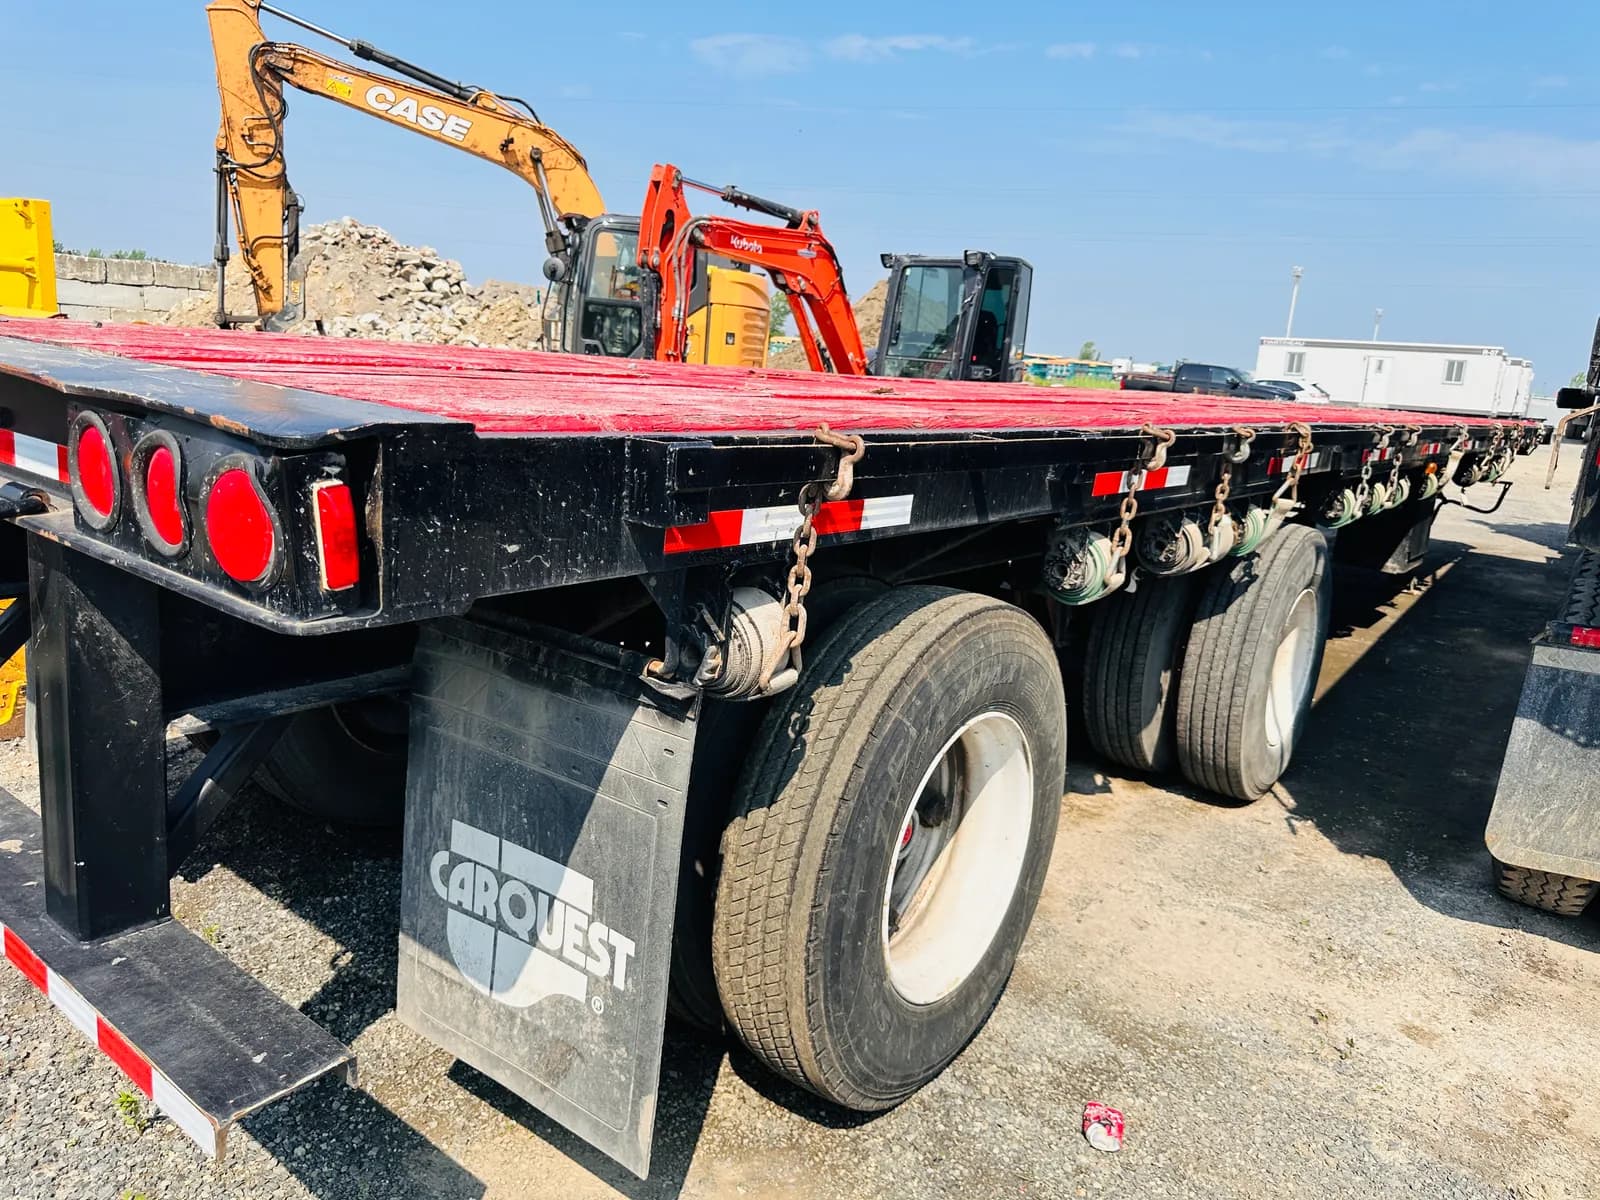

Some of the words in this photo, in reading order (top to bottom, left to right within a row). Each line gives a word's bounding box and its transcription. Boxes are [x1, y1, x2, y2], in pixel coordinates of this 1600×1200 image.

[365, 85, 473, 142] CASE
[730, 235, 763, 255] Kubota
[429, 850, 636, 991] CARQUEST
